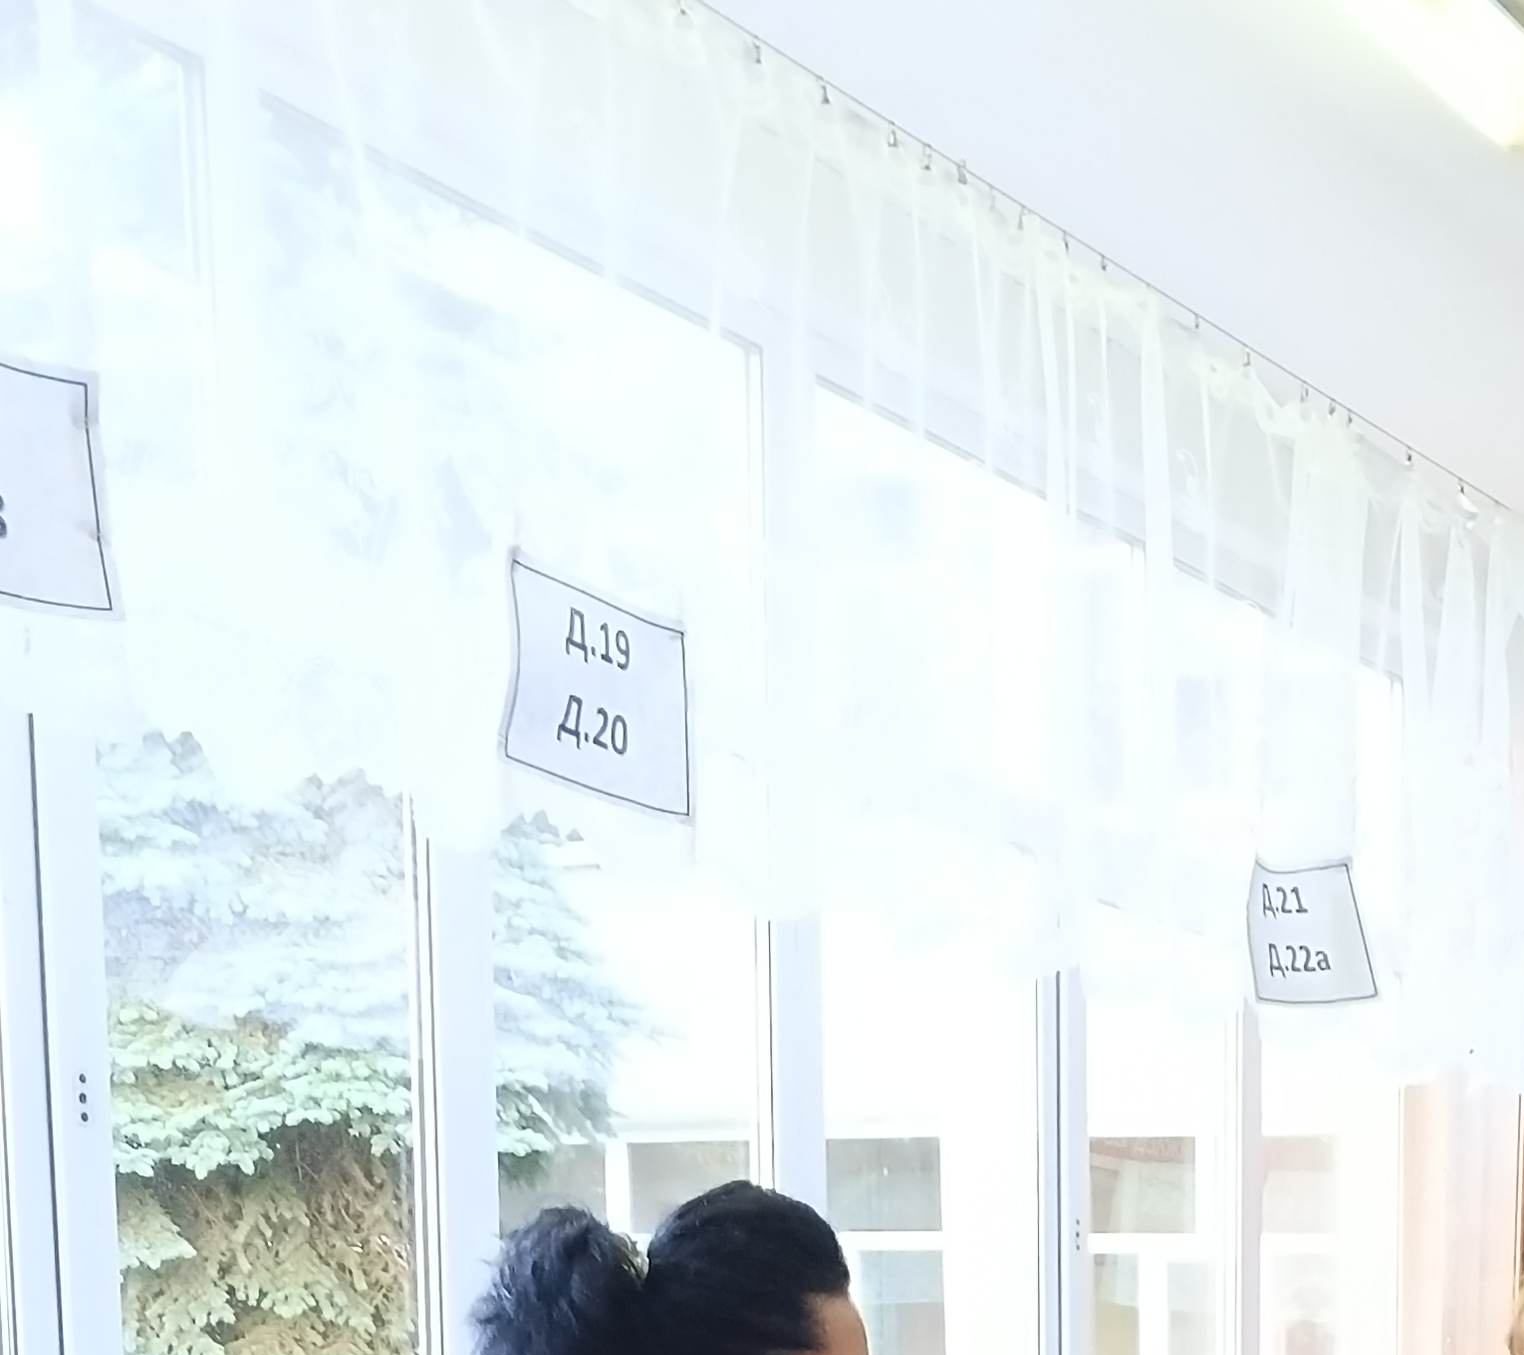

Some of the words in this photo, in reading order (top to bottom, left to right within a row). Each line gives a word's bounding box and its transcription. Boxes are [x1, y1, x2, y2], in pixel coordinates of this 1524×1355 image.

[564, 606, 631, 671] Д.19
[556, 694, 629, 756] Д.20
[1262, 882, 1309, 919] Д.21
[1268, 942, 1332, 979] Д.22а
